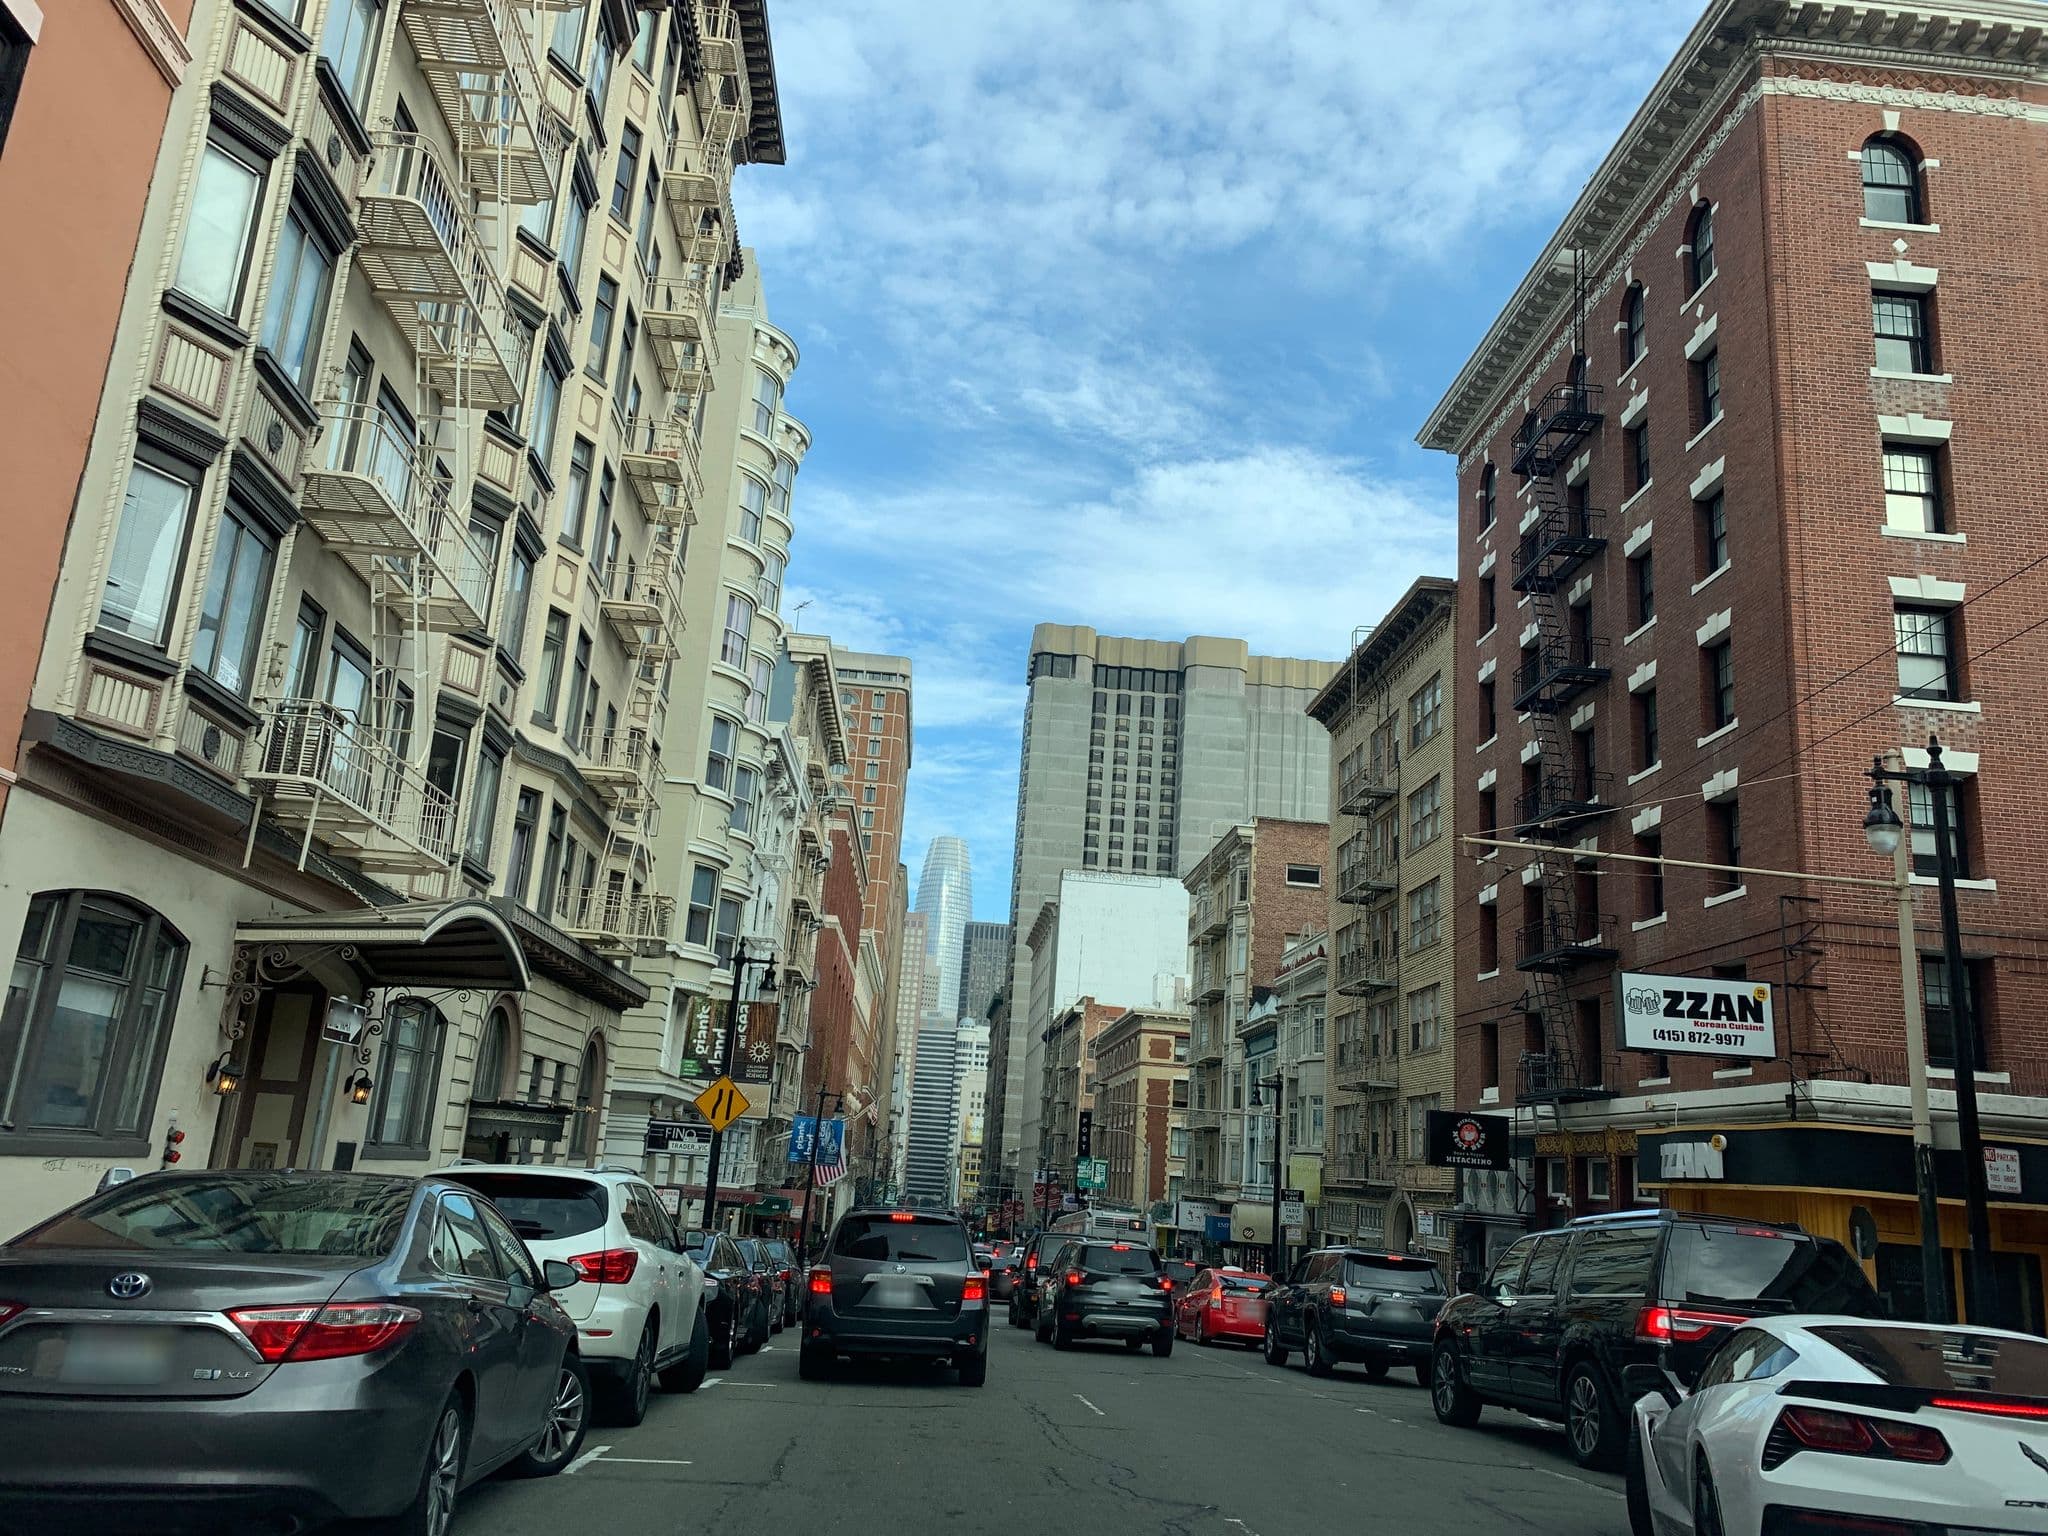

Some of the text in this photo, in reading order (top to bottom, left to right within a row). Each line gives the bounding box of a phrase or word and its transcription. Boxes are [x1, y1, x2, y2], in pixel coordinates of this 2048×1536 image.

[1663, 990, 1764, 1023] ZZAN
[737, 1004, 749, 1032] sea
[1693, 1020, 1765, 1032] Korean Cuisine
[693, 1004, 711, 1055] giants
[1653, 1029, 1745, 1046] (415) 872-9977
[708, 1028, 727, 1064] land
[665, 1127, 696, 1140] FINO
[671, 1143, 695, 1151] TRADER
[1985, 1149, 2017, 1162] NO PARKING
[1446, 1155, 1492, 1165] HITACHINO
[1660, 1142, 1724, 1178] ZZAN
